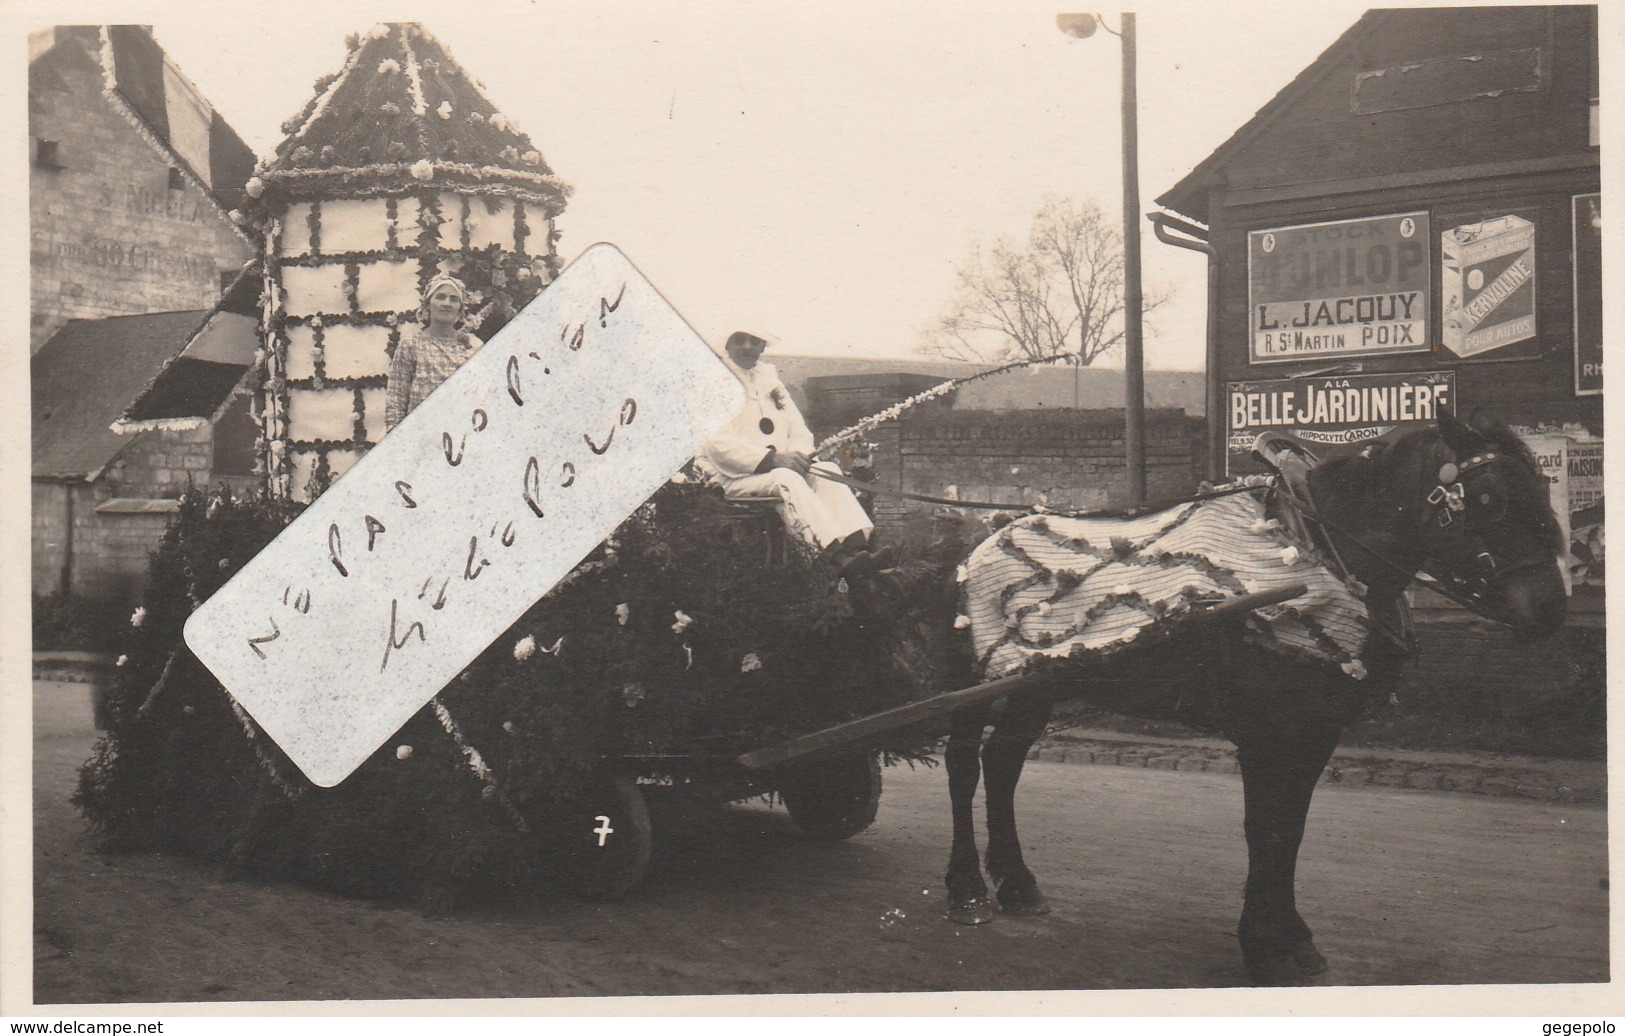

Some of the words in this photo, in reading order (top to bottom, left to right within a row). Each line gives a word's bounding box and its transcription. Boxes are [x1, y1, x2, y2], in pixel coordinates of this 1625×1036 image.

[1463, 259, 1532, 326] KERVOLINE
[1294, 331, 1345, 351] MARTIN
[1362, 323, 1414, 346] POIX
[1465, 331, 1494, 350] POUR
[1496, 320, 1531, 340] AUTOS
[1335, 379, 1350, 388] LA
[1231, 391, 1295, 429] BELLE
[1296, 382, 1449, 425] JARDINIÈRE
[1300, 429, 1345, 443] HIPPOLYTE
[1344, 427, 1379, 442] CARON
